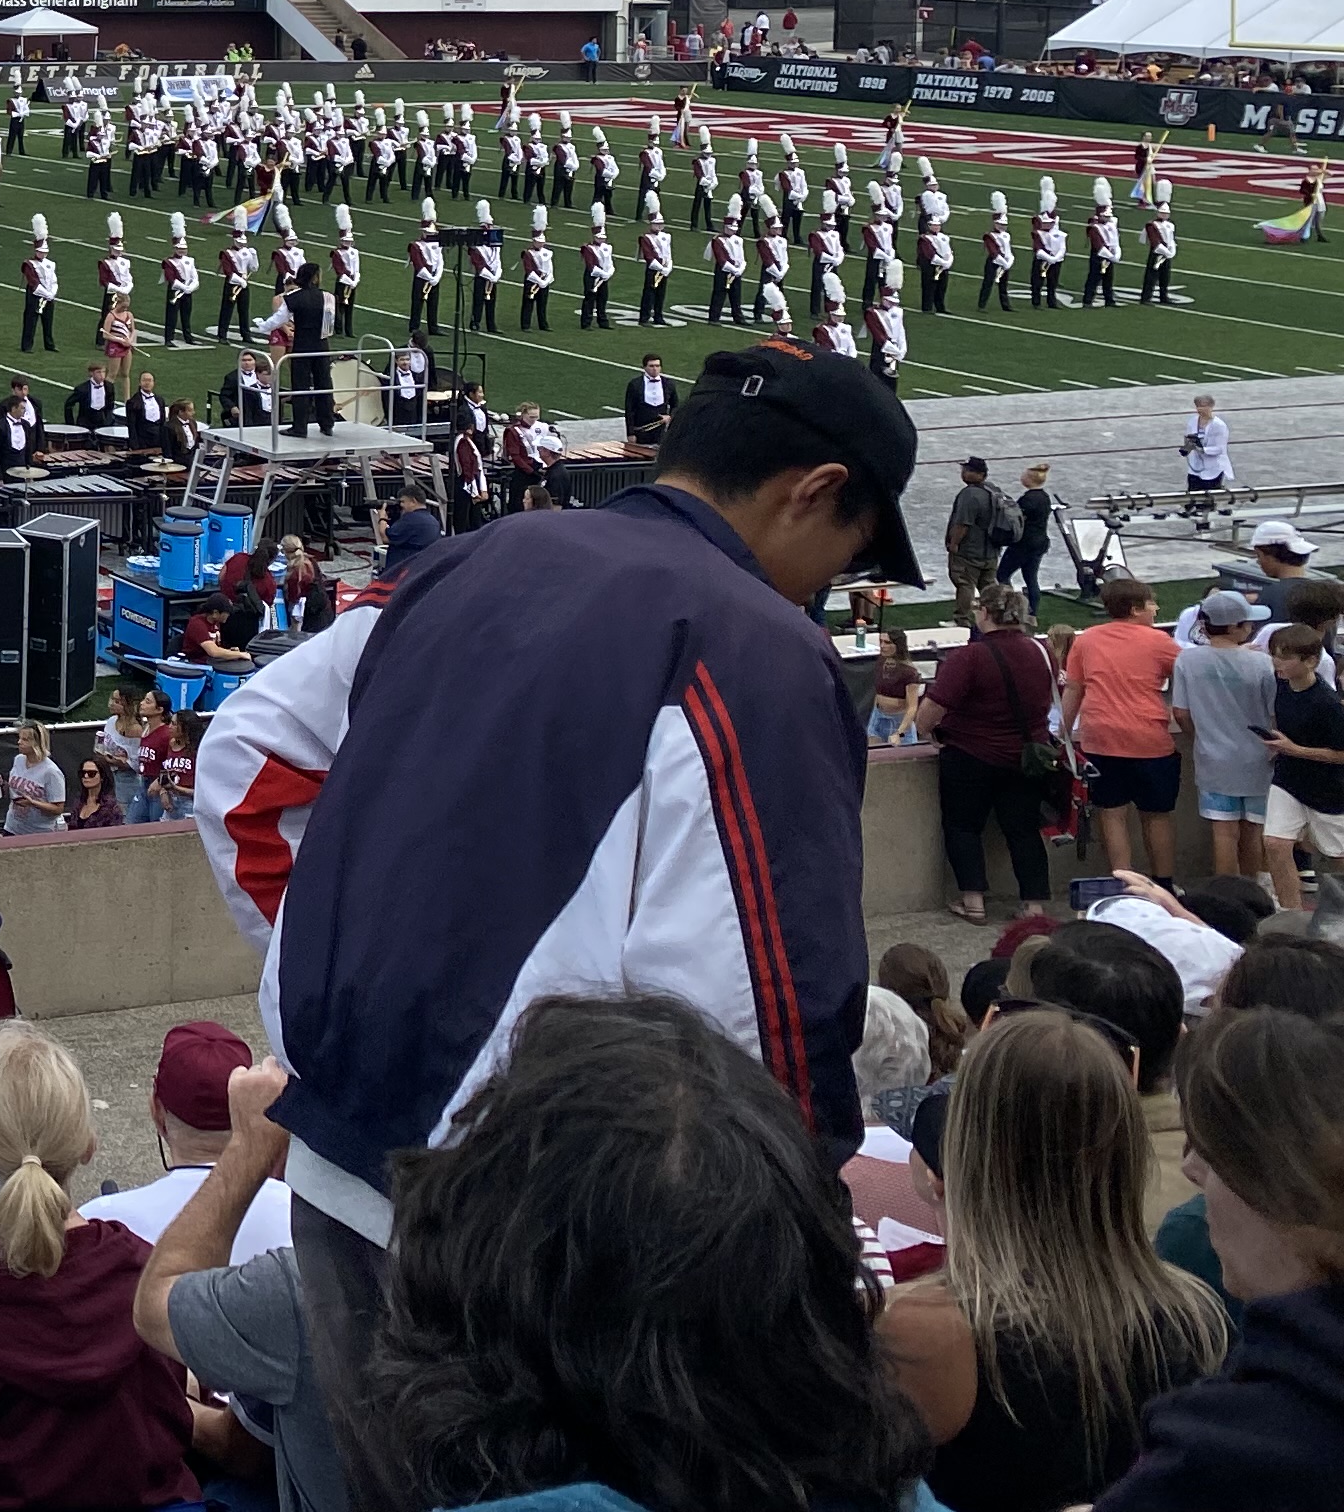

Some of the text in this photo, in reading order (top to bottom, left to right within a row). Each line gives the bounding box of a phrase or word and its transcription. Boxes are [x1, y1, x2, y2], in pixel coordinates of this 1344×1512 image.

[774, 76, 839, 93] CHAMPIONS
[780, 63, 887, 90] NATIONAL 1998
[47, 85, 118, 98] Tickmarter
[912, 87, 977, 105] FINALISTS
[917, 73, 1056, 103] NATIONAL 1978 2006
[163, 758, 192, 771] MASS
